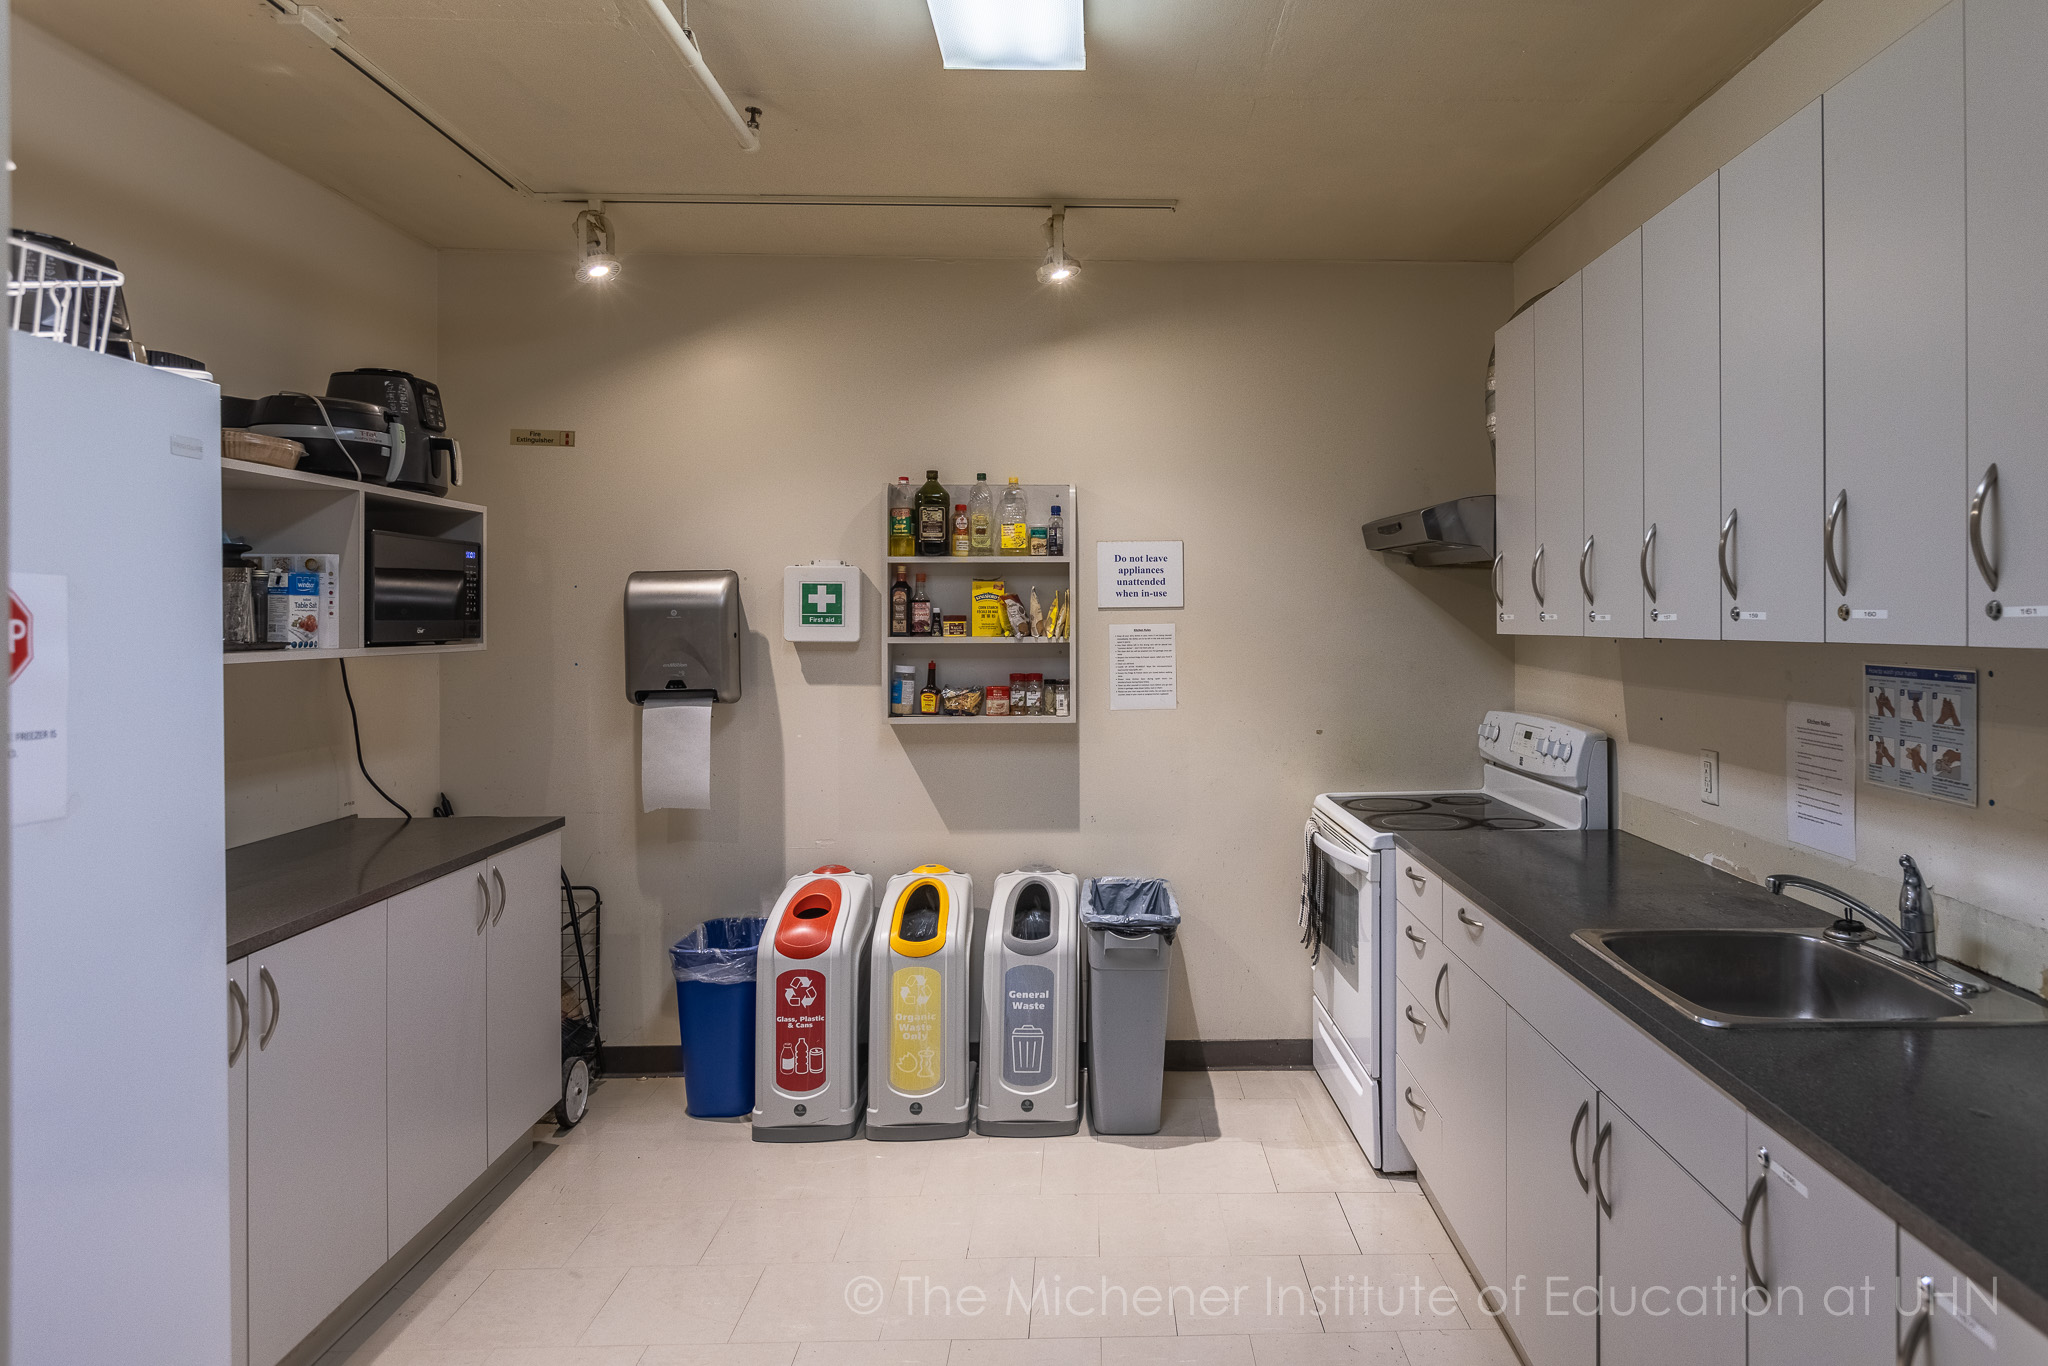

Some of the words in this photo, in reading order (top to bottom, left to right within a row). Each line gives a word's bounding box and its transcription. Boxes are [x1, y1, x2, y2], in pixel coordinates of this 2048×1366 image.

[516, 436, 554, 444] Extinguisher
[1114, 554, 1127, 563] Do
[1129, 555, 1144, 563] not
[1145, 554, 1168, 563] leave
[1118, 566, 1164, 576] appliances
[1116, 577, 1166, 586] unattended
[1115, 589, 1139, 597] when
[1141, 589, 1168, 597] in-use
[2020, 607, 2037, 615] 161
[1008, 990, 1049, 998] General
[1012, 1001, 1045, 1010] Waste
[895, 1012, 937, 1022] Organic
[899, 1023, 932, 1031] Waste
[902, 1031, 928, 1041] Only
